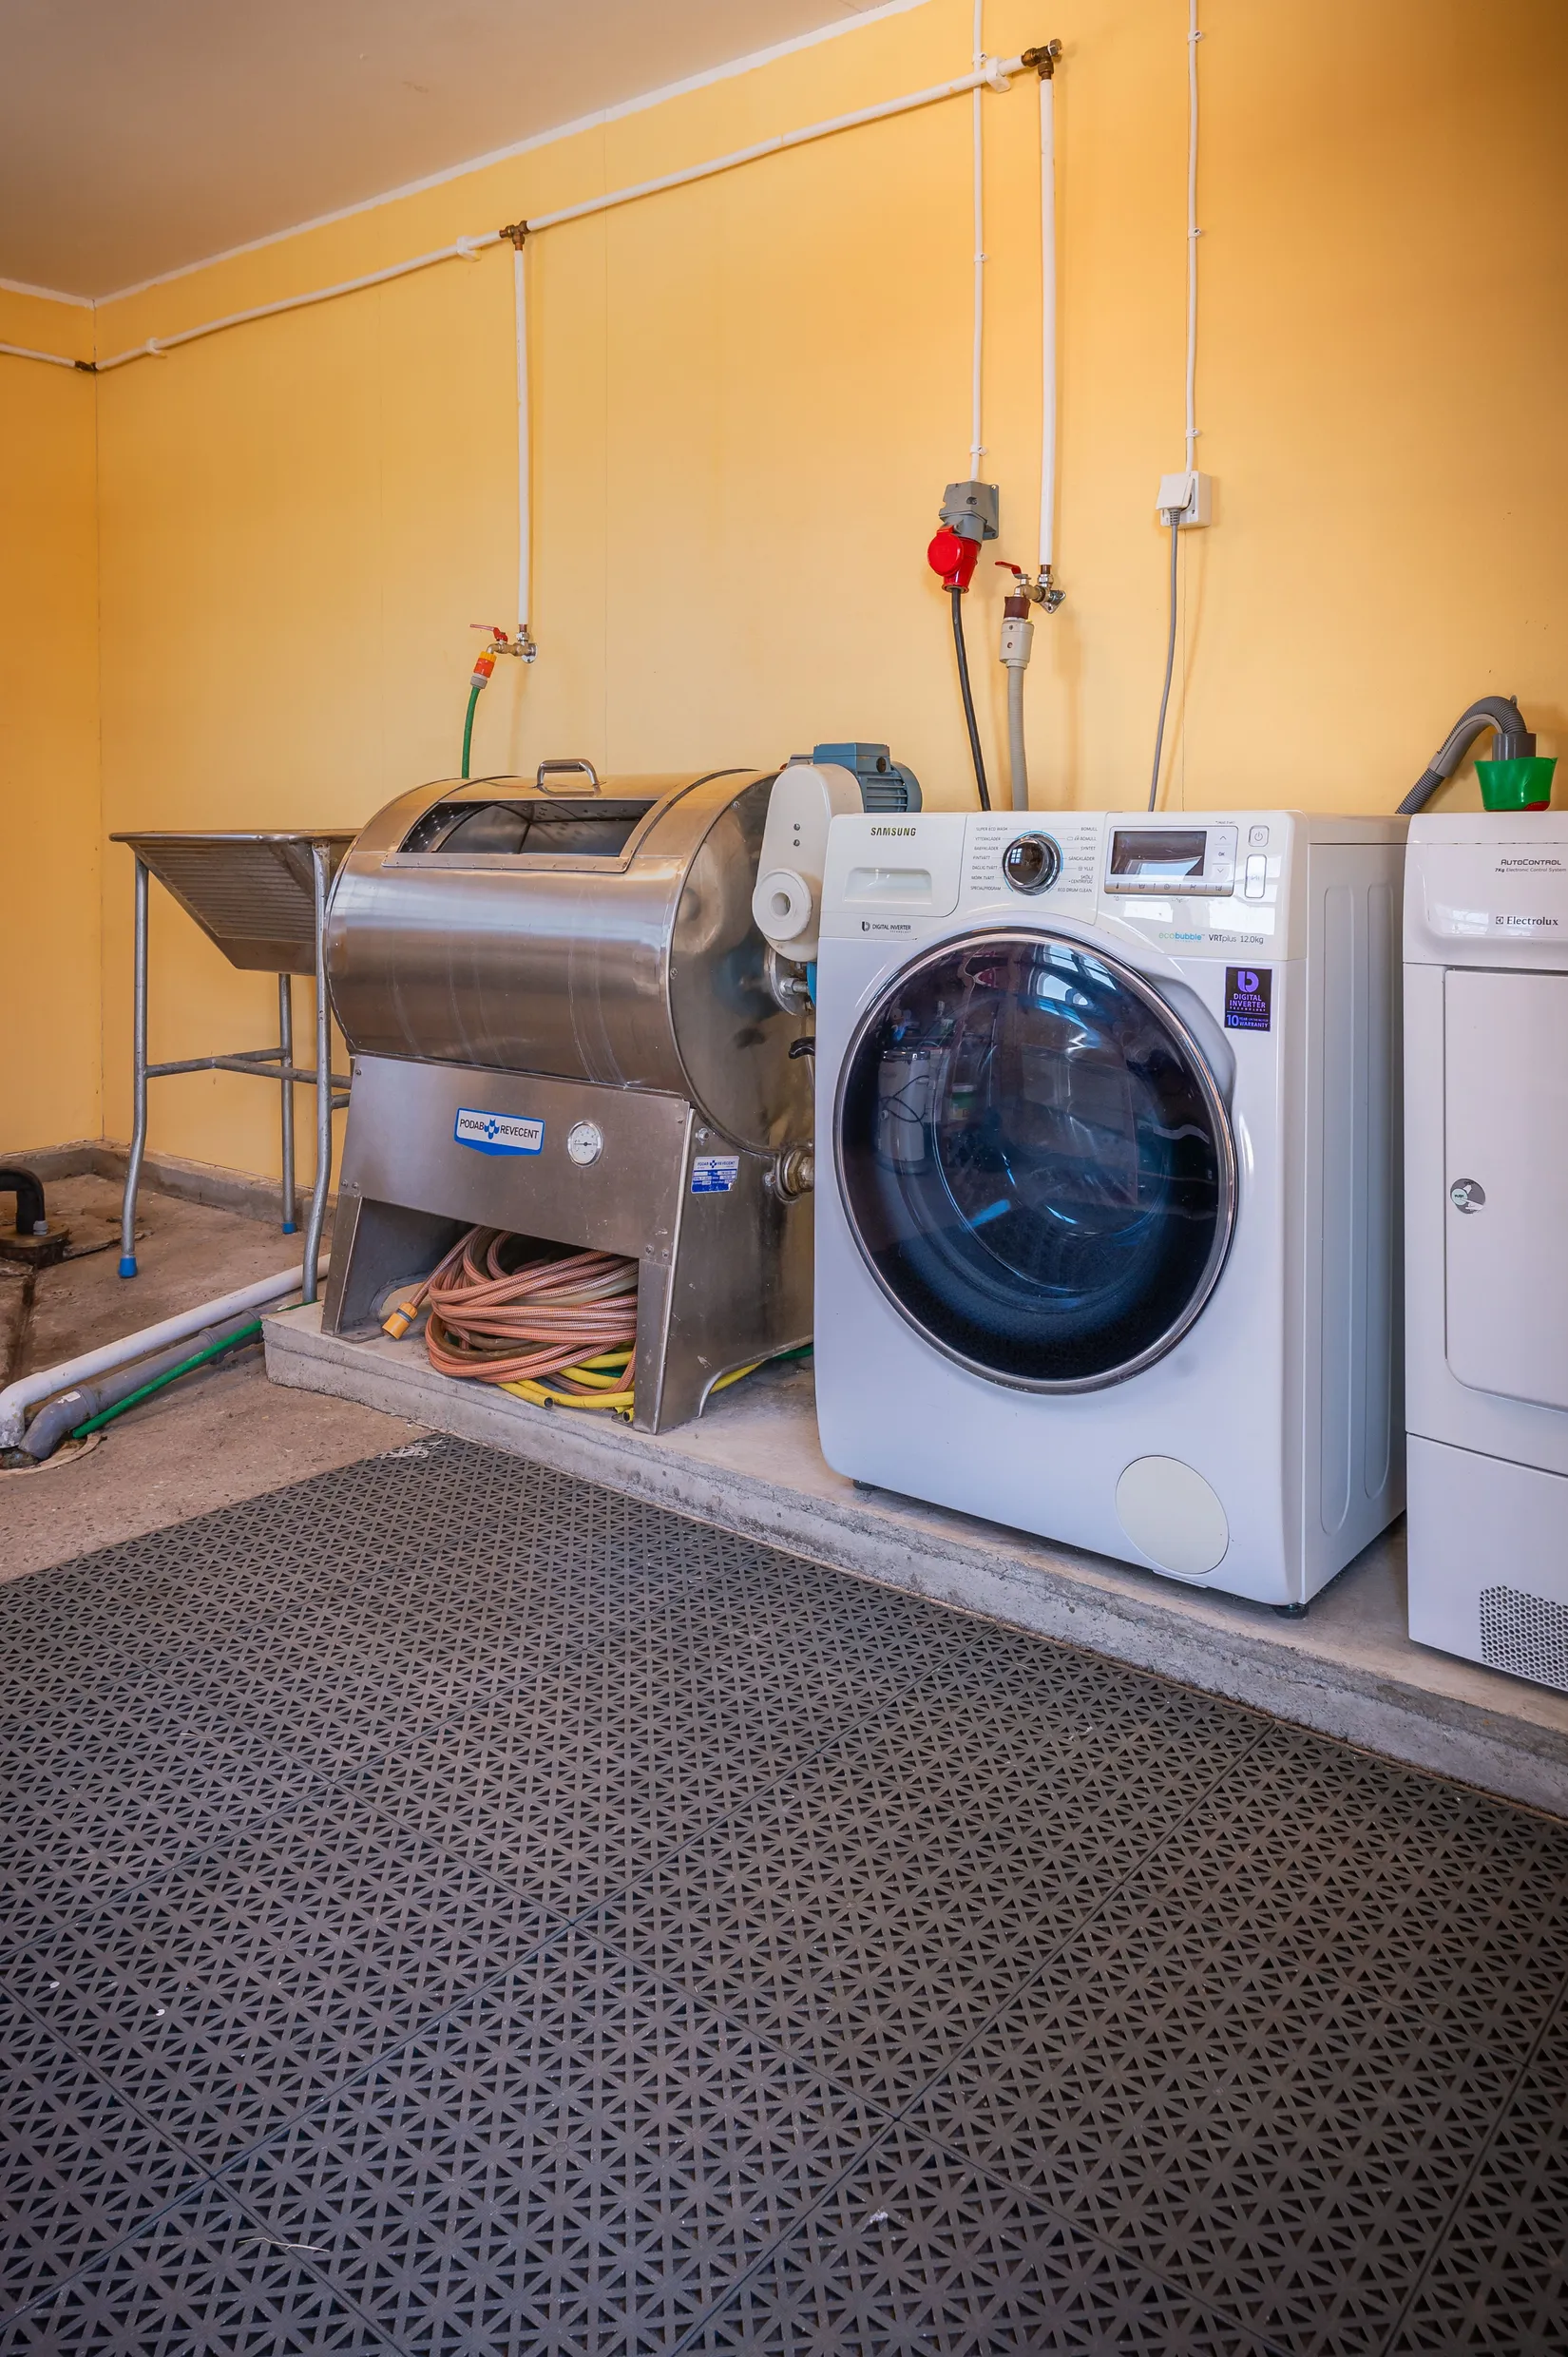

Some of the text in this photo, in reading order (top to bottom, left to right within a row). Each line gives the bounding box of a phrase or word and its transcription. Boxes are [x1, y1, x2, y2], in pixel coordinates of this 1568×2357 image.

[871, 827, 917, 836] SAMSUNG
[1507, 916, 1558, 925] Electrolux
[1209, 934, 1237, 942] VRTplus
[1240, 936, 1264, 944] 12.0kg
[1229, 1000, 1265, 1008] INVERTER
[1227, 1015, 1239, 1026] 10
[460, 1119, 539, 1139] PODAB REVECENT
